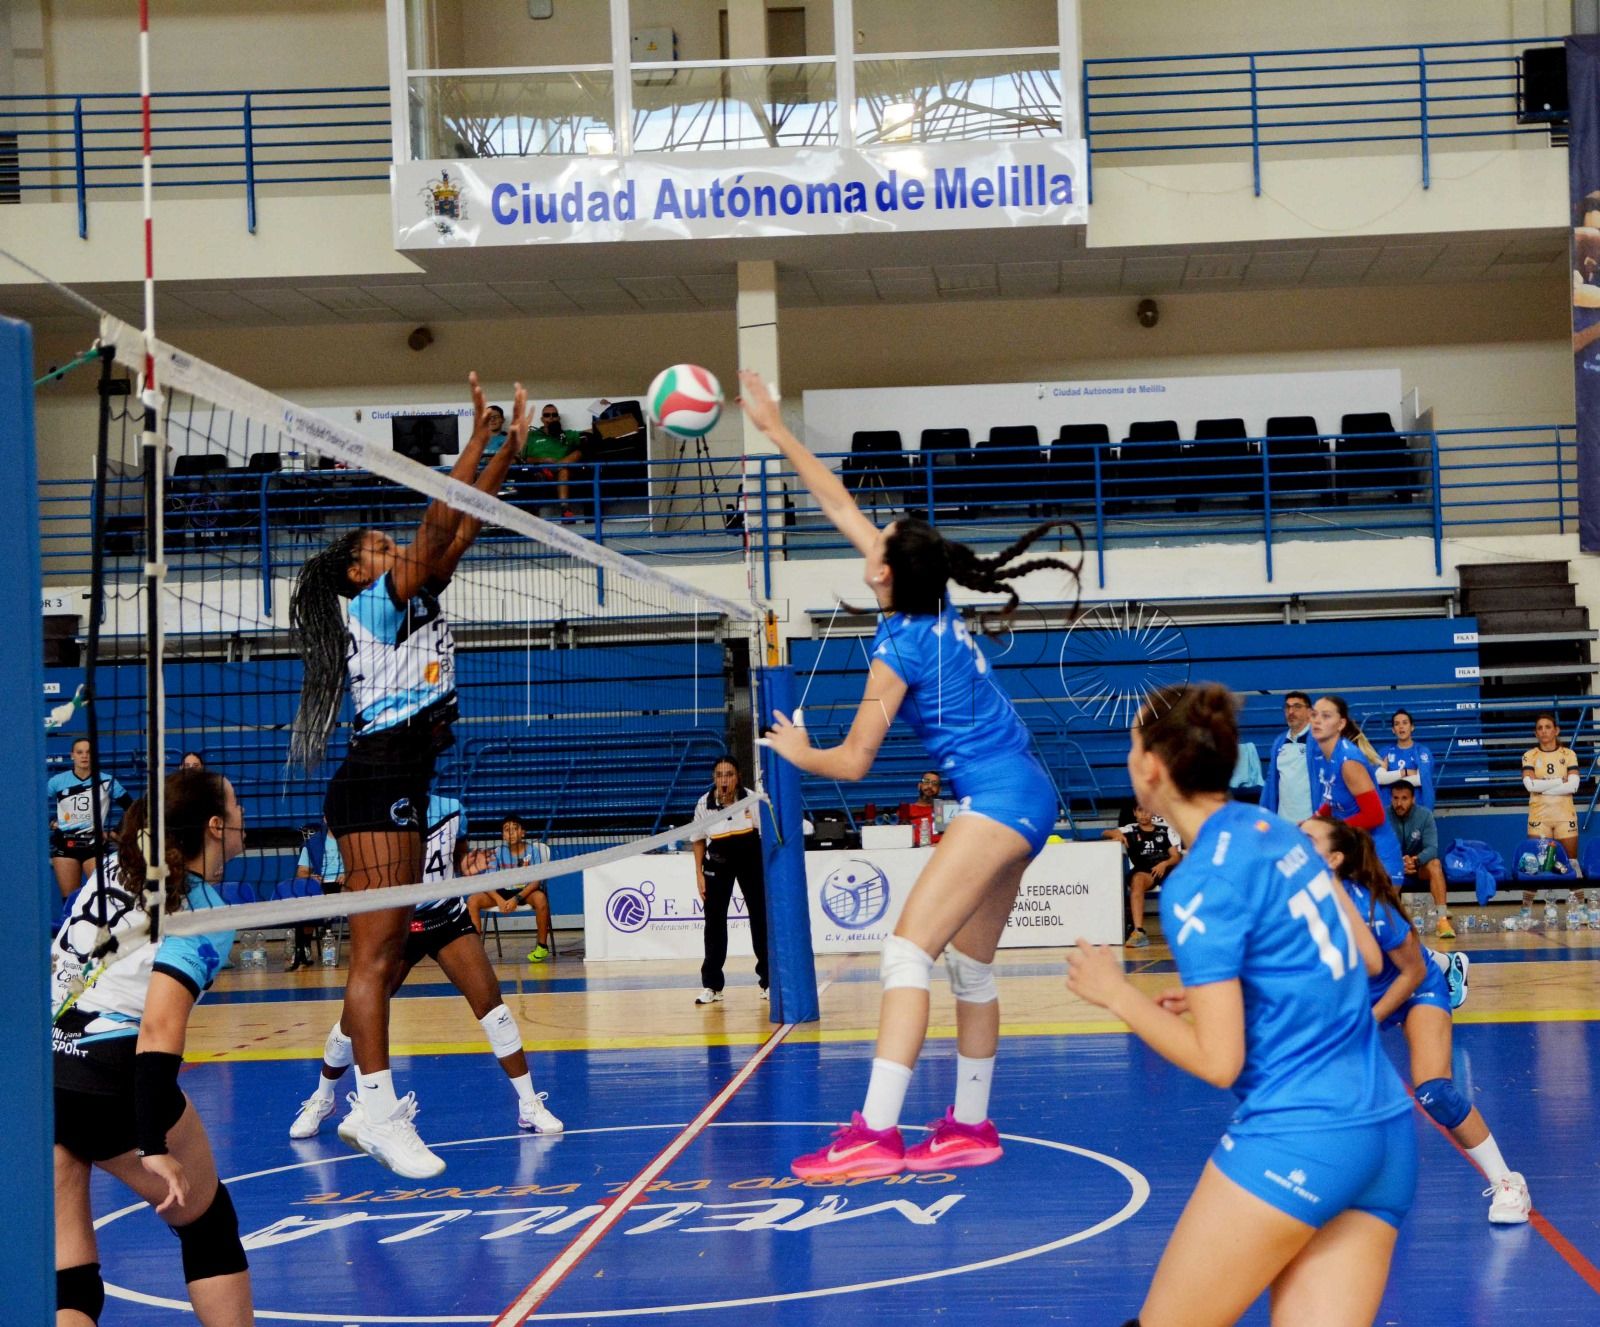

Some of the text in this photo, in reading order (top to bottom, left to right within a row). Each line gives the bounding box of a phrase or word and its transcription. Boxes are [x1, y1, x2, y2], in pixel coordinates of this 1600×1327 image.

[491, 164, 1073, 225] Ciudad Autónoma de Melilla
[1053, 388, 1081, 397] Ciudad
[1126, 386, 1137, 394] de
[1139, 384, 1166, 394] Melilla
[57, 598, 63, 608] 3
[1546, 763, 1555, 775] 8
[71, 796, 90, 811] 13
[1144, 840, 1155, 849] 21
[425, 849, 447, 877] 4
[1026, 882, 1089, 897] FEDERACIÓN
[1011, 898, 1051, 912] PAÑOLA
[651, 922, 689, 931] Federación
[1015, 915, 1064, 927] VOLEIBOL
[1287, 869, 1358, 982] 17
[289, 1182, 582, 1204] DEPORTE
[240, 1194, 967, 1252] MELILLA
